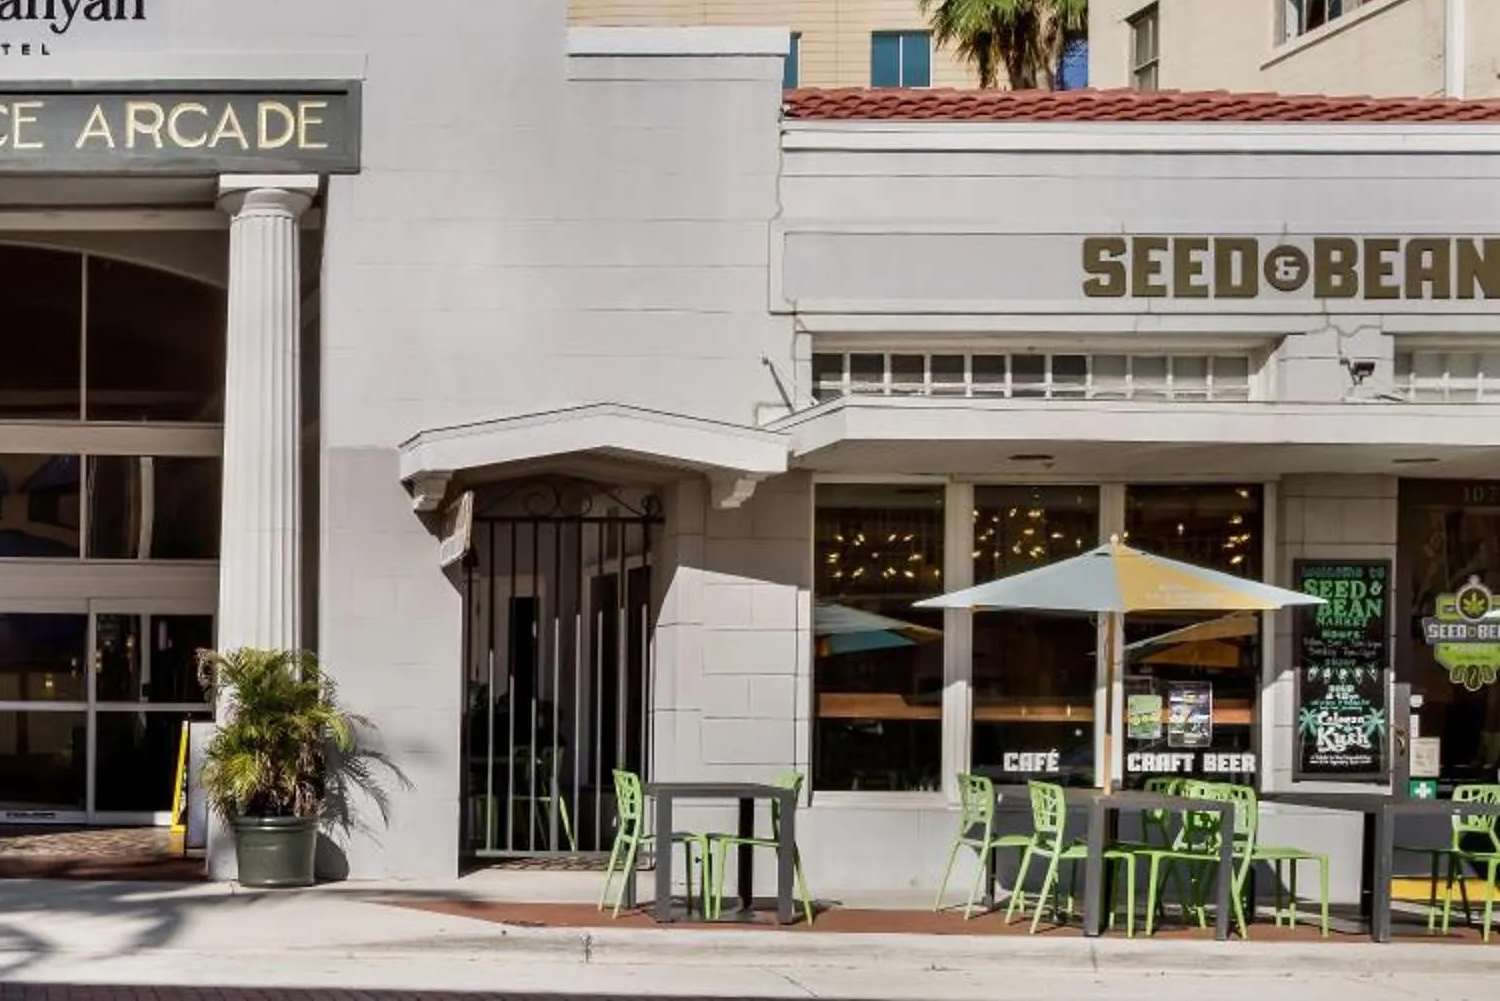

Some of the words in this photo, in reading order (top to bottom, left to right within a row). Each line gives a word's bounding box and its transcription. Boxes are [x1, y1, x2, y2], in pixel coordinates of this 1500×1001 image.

[75, 101, 329, 150] ARCADE
[1082, 237, 1259, 299] SEED
[1313, 237, 1500, 300] BEAN
[1303, 579, 1366, 599] SEED
[1370, 581, 1383, 596] &
[1318, 599, 1382, 618] BEAN
[1427, 623, 1467, 639] SEED
[1003, 749, 1060, 772] CAFÉ
[1127, 752, 1195, 772] CRAFT
[1203, 752, 1256, 772] BEER
